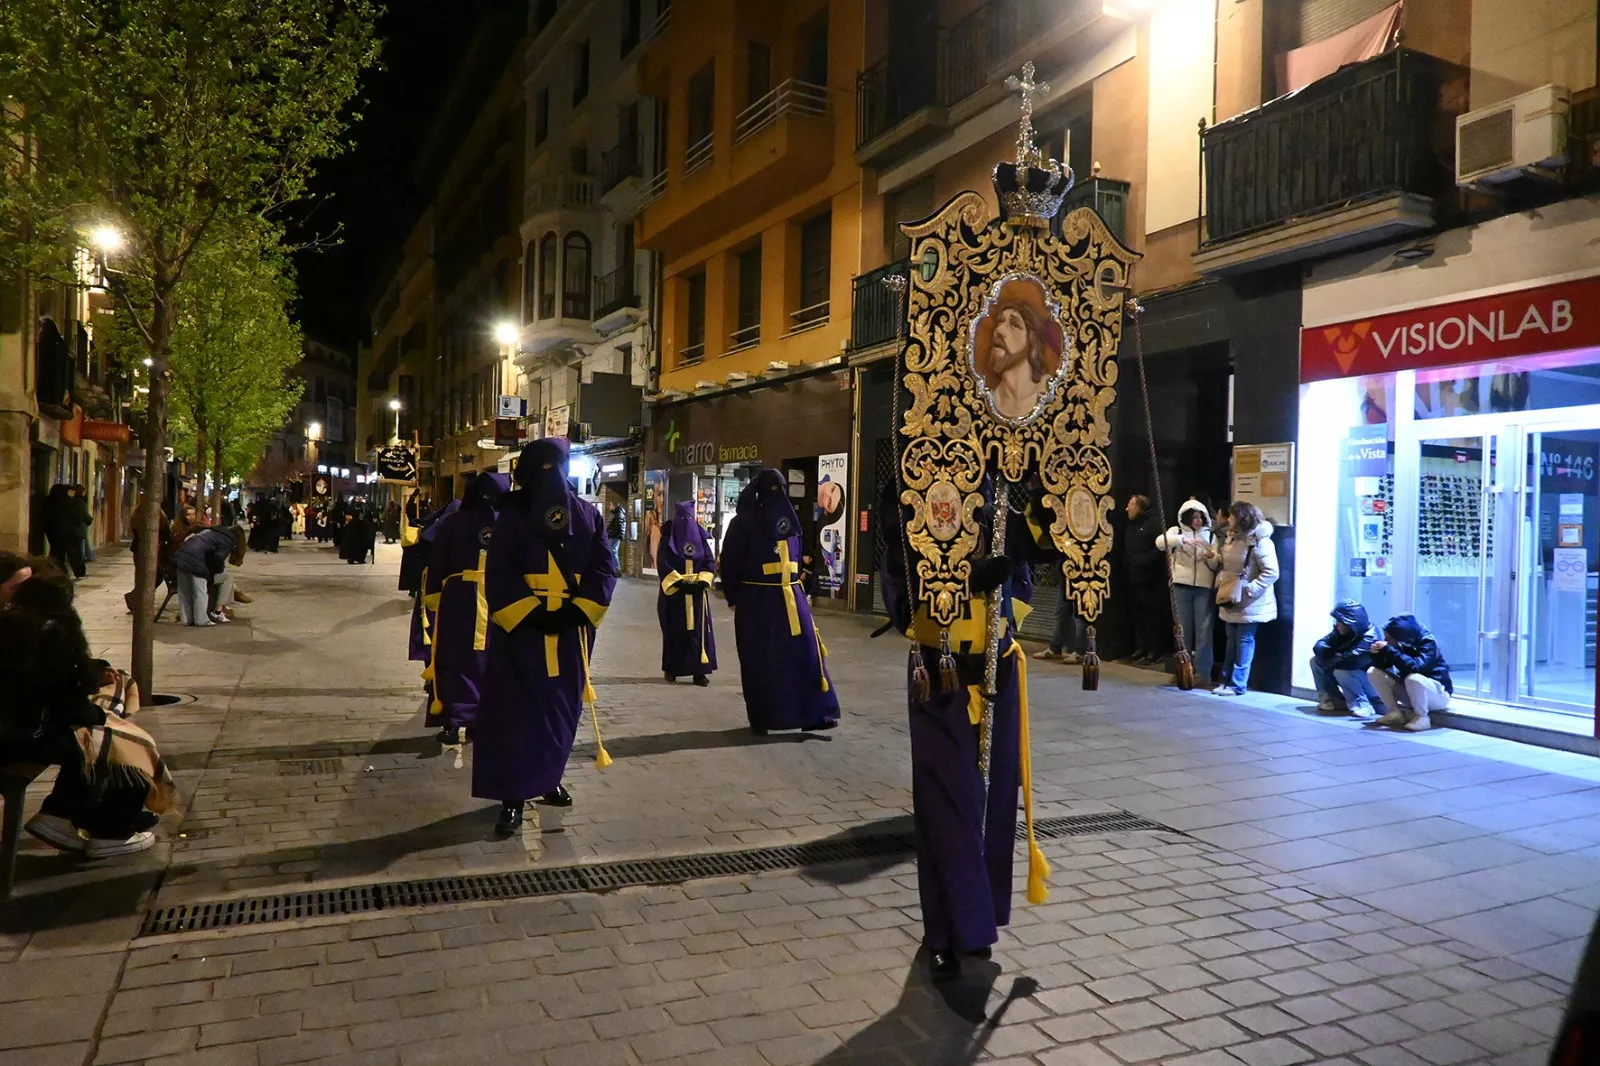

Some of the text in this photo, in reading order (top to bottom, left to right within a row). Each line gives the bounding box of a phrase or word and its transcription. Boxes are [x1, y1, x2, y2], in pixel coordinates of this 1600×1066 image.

[1372, 299, 1573, 359] VISIONLAB
[676, 442, 758, 465] marro farmacia
[821, 458, 845, 469] PHYTO
[1360, 447, 1387, 460] Vista
[1565, 454, 1594, 481] 146
